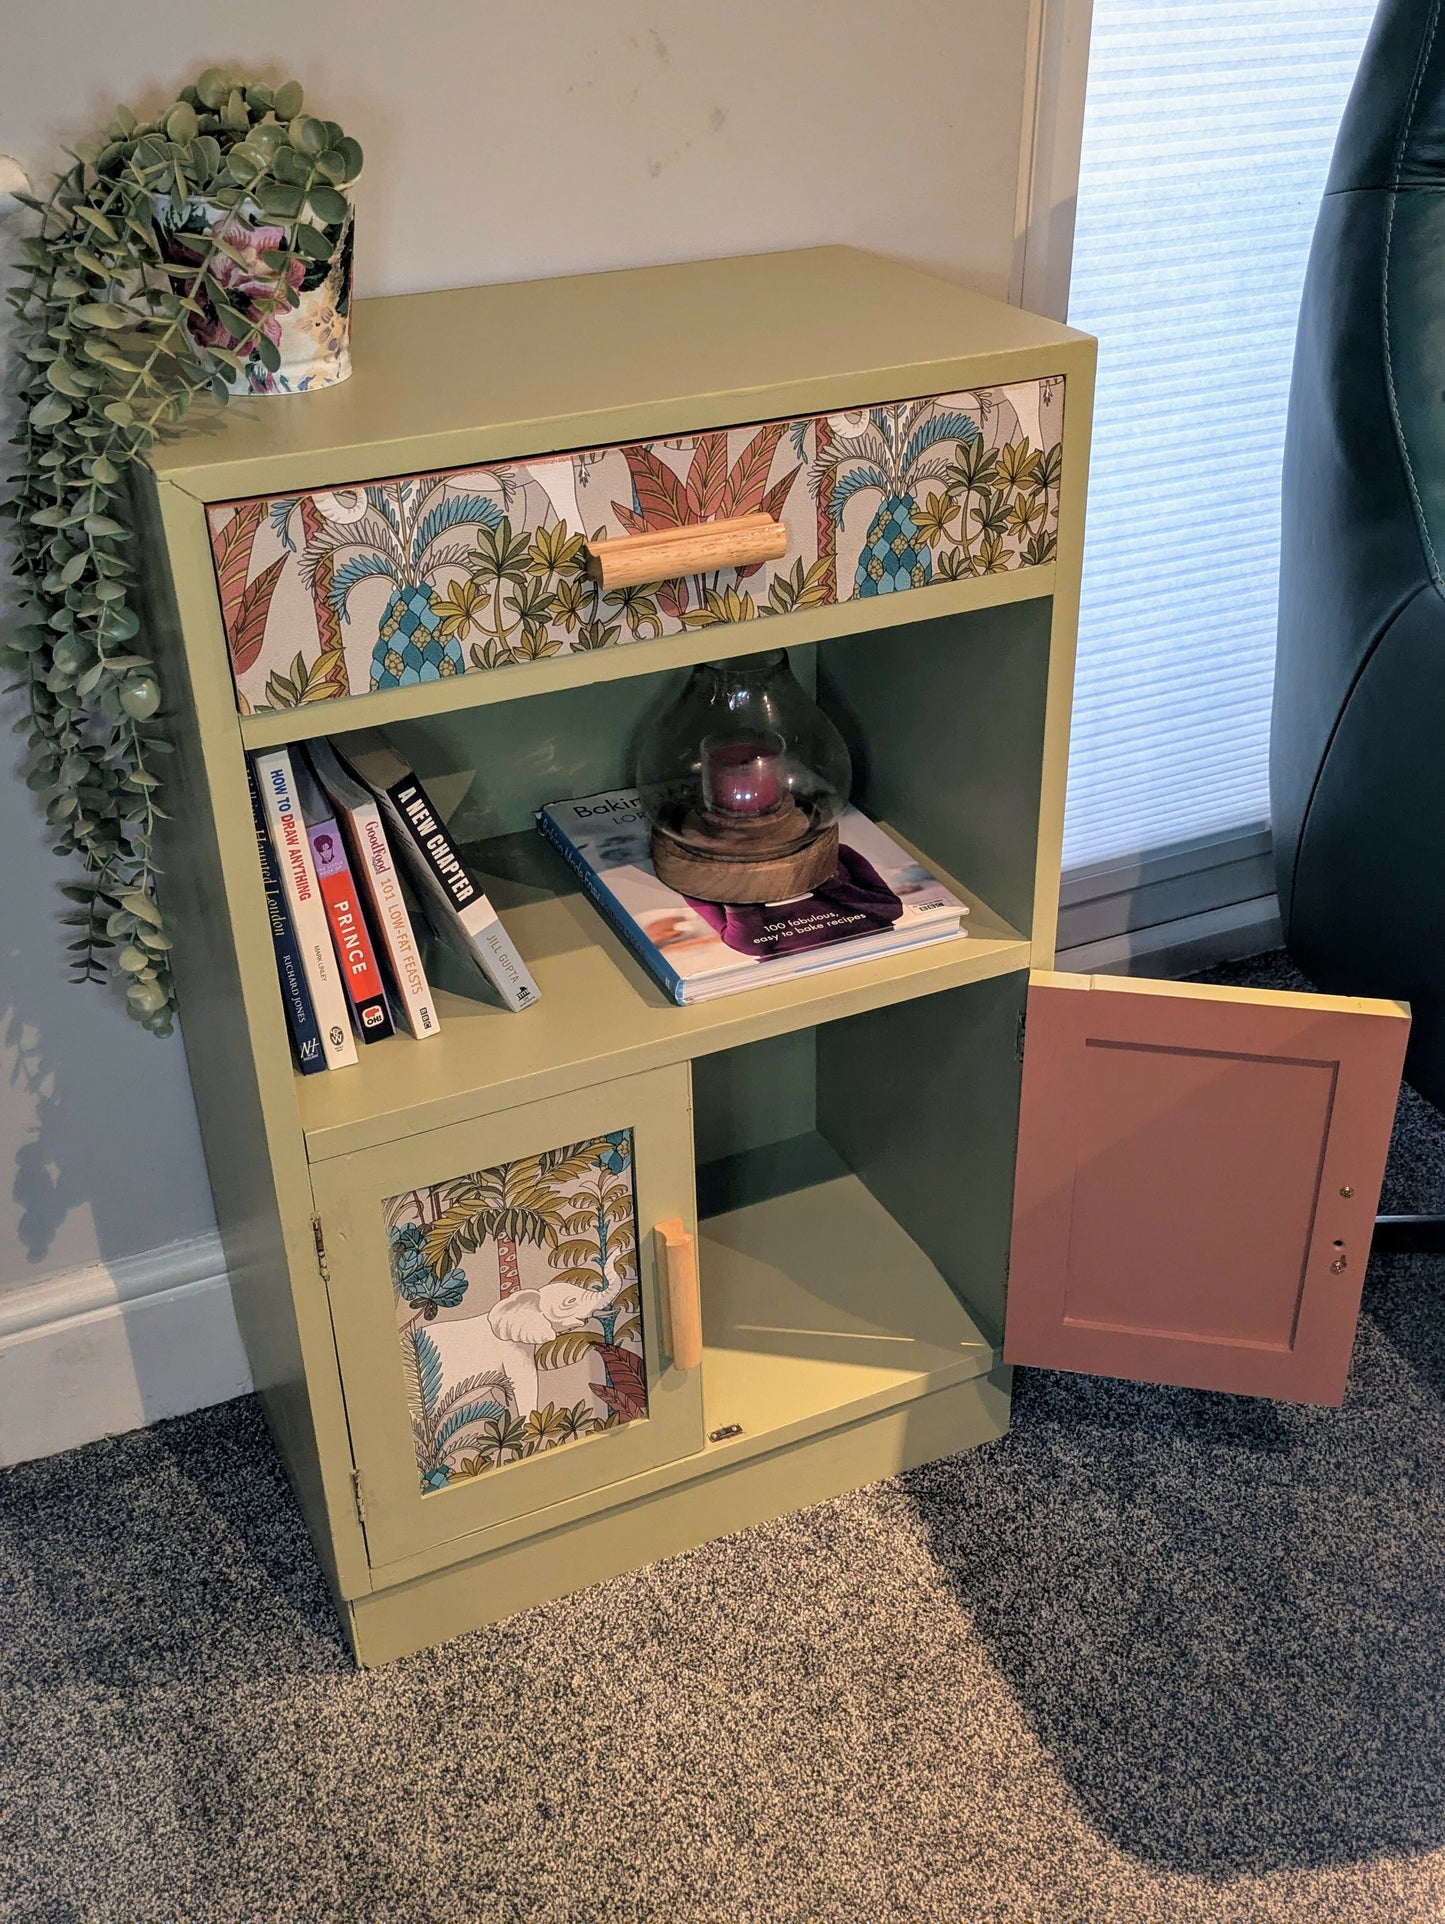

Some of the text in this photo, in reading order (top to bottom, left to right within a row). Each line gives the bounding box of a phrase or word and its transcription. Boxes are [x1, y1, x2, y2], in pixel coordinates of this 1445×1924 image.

[270, 768, 311, 901] HOW TO DRAW ANYTHING
[397, 786, 474, 902] A NEW CHAPTER
[265, 889, 287, 936] London
[753, 912, 866, 945] easy to bake recipes
[764, 911, 839, 932] 100 fabulous,
[314, 945, 323, 963] MARK
[333, 900, 368, 975] PRINCE
[380, 878, 424, 996] 101 LOW-FAT FEASTS
[486, 935, 520, 984] JILL GUPTA
[283, 954, 306, 1023] RICHARD JONES
[366, 1015, 382, 1026] OH!
[419, 1006, 432, 1030] BBC
